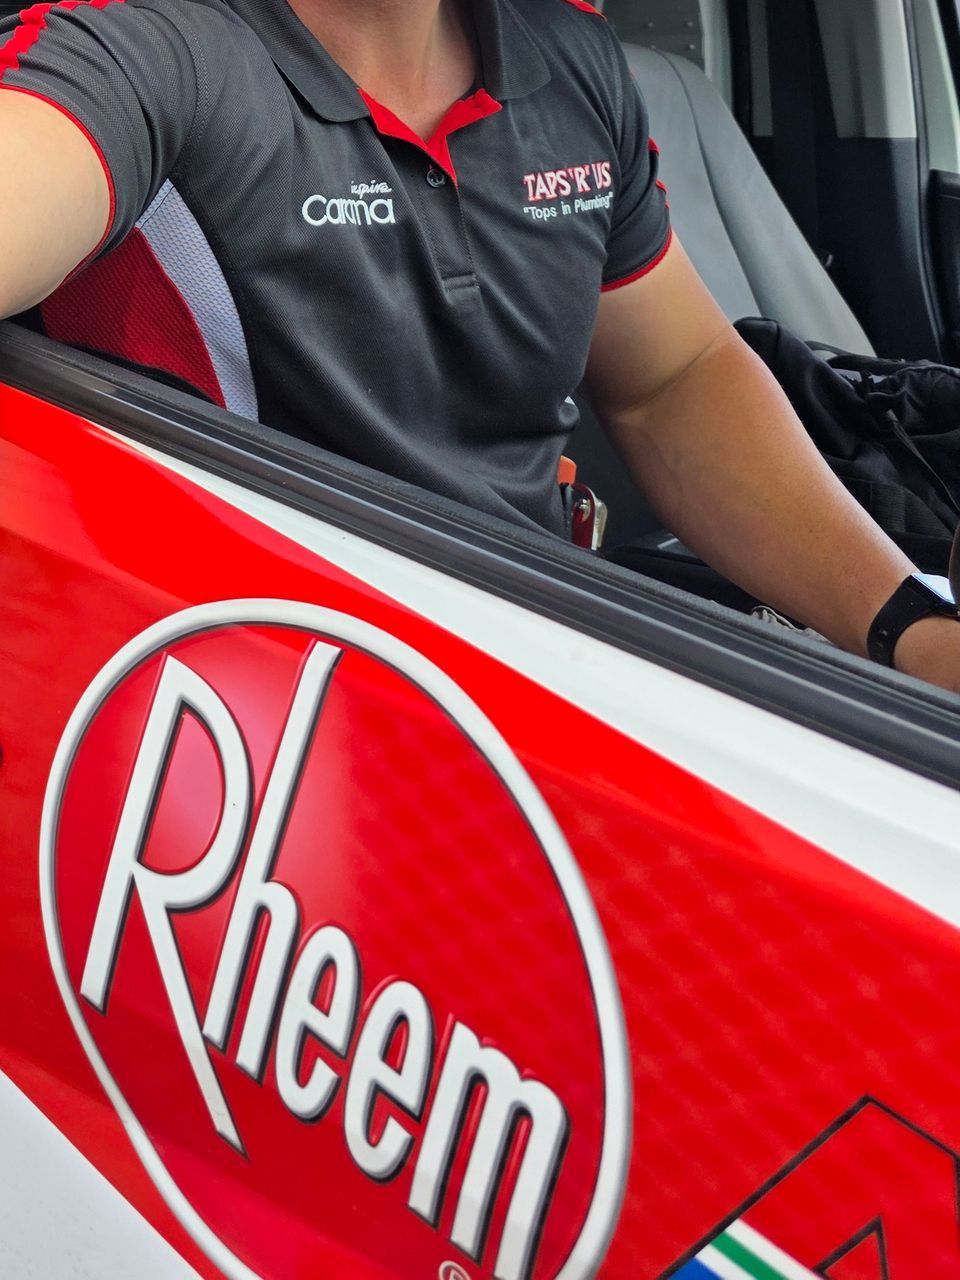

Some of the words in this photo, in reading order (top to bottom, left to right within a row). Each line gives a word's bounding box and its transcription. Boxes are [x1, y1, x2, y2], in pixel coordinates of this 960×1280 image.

[350, 179, 393, 199] inspire
[523, 170, 571, 202] TAPS
[591, 161, 612, 189] US
[523, 206, 558, 221] "Tops
[560, 201, 572, 215] in
[574, 191, 614, 213] Plumbing"
[78, 639, 572, 1280] Rheem
